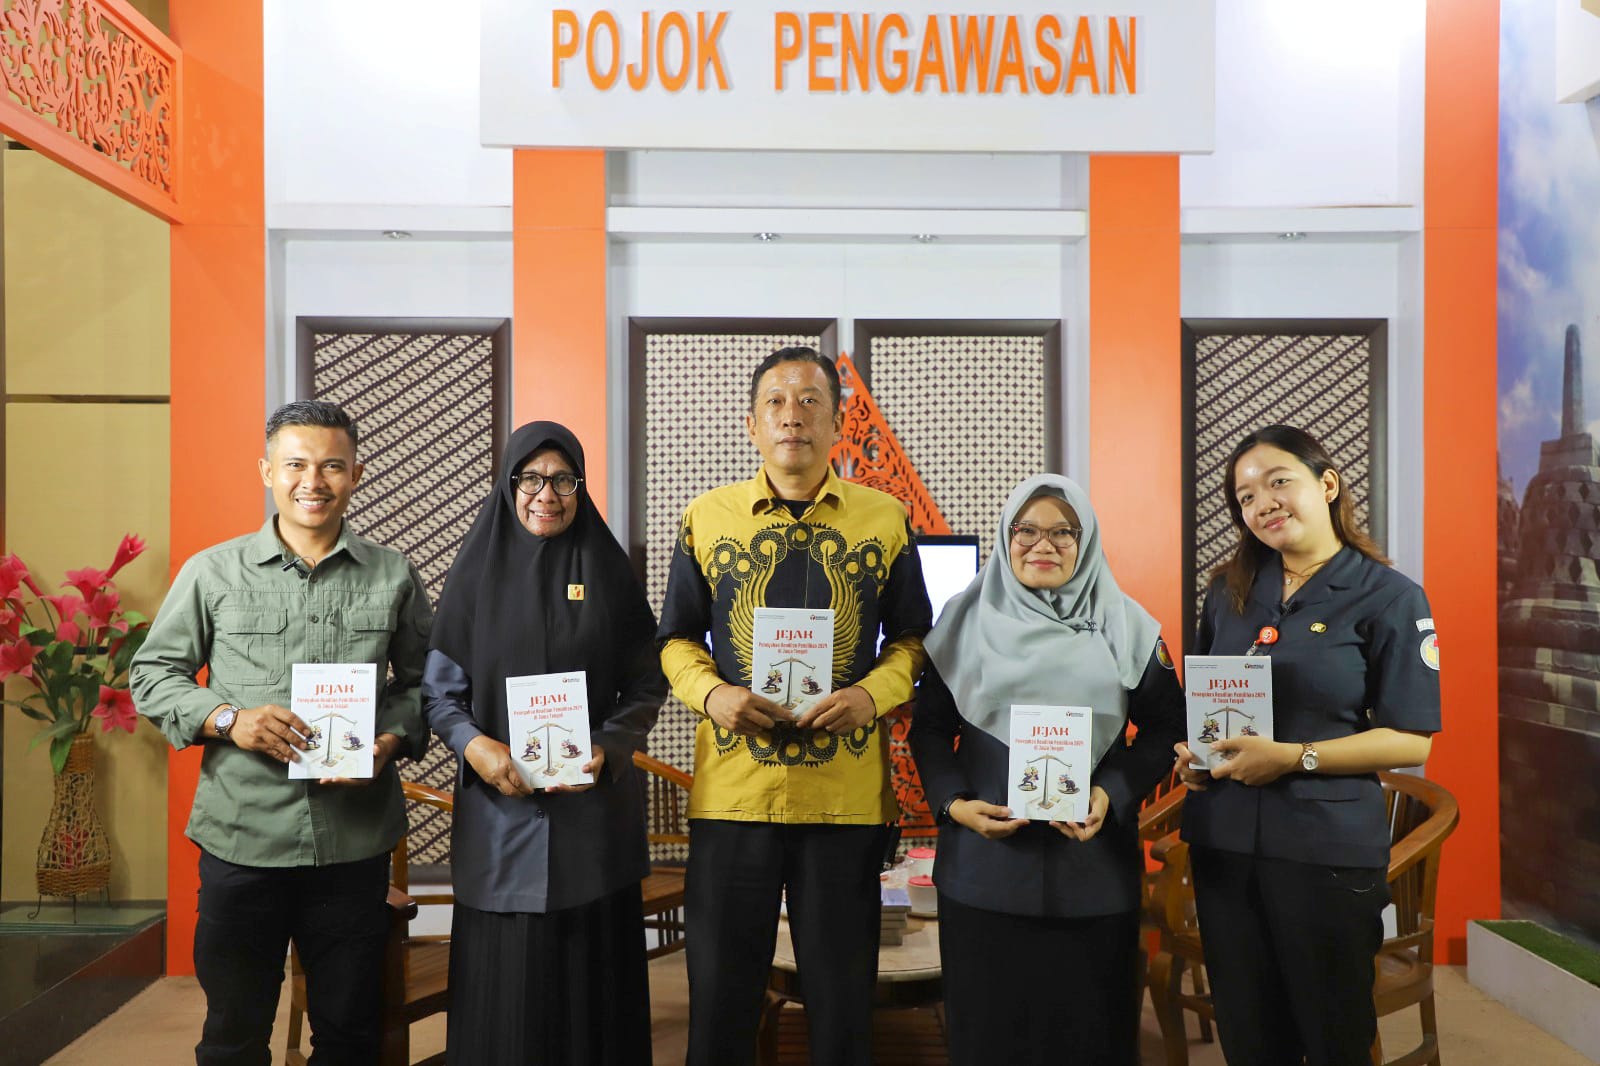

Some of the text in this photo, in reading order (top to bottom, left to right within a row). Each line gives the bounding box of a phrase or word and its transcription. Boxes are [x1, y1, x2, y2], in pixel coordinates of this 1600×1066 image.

[552, 9, 1137, 95] POJOK PENGAWASAN
[774, 629, 813, 640] JEJAK
[315, 684, 354, 695] JEJAK
[1207, 679, 1249, 690] JEJAK
[529, 694, 567, 707] JEJAK
[1032, 726, 1069, 737] JEJAK
